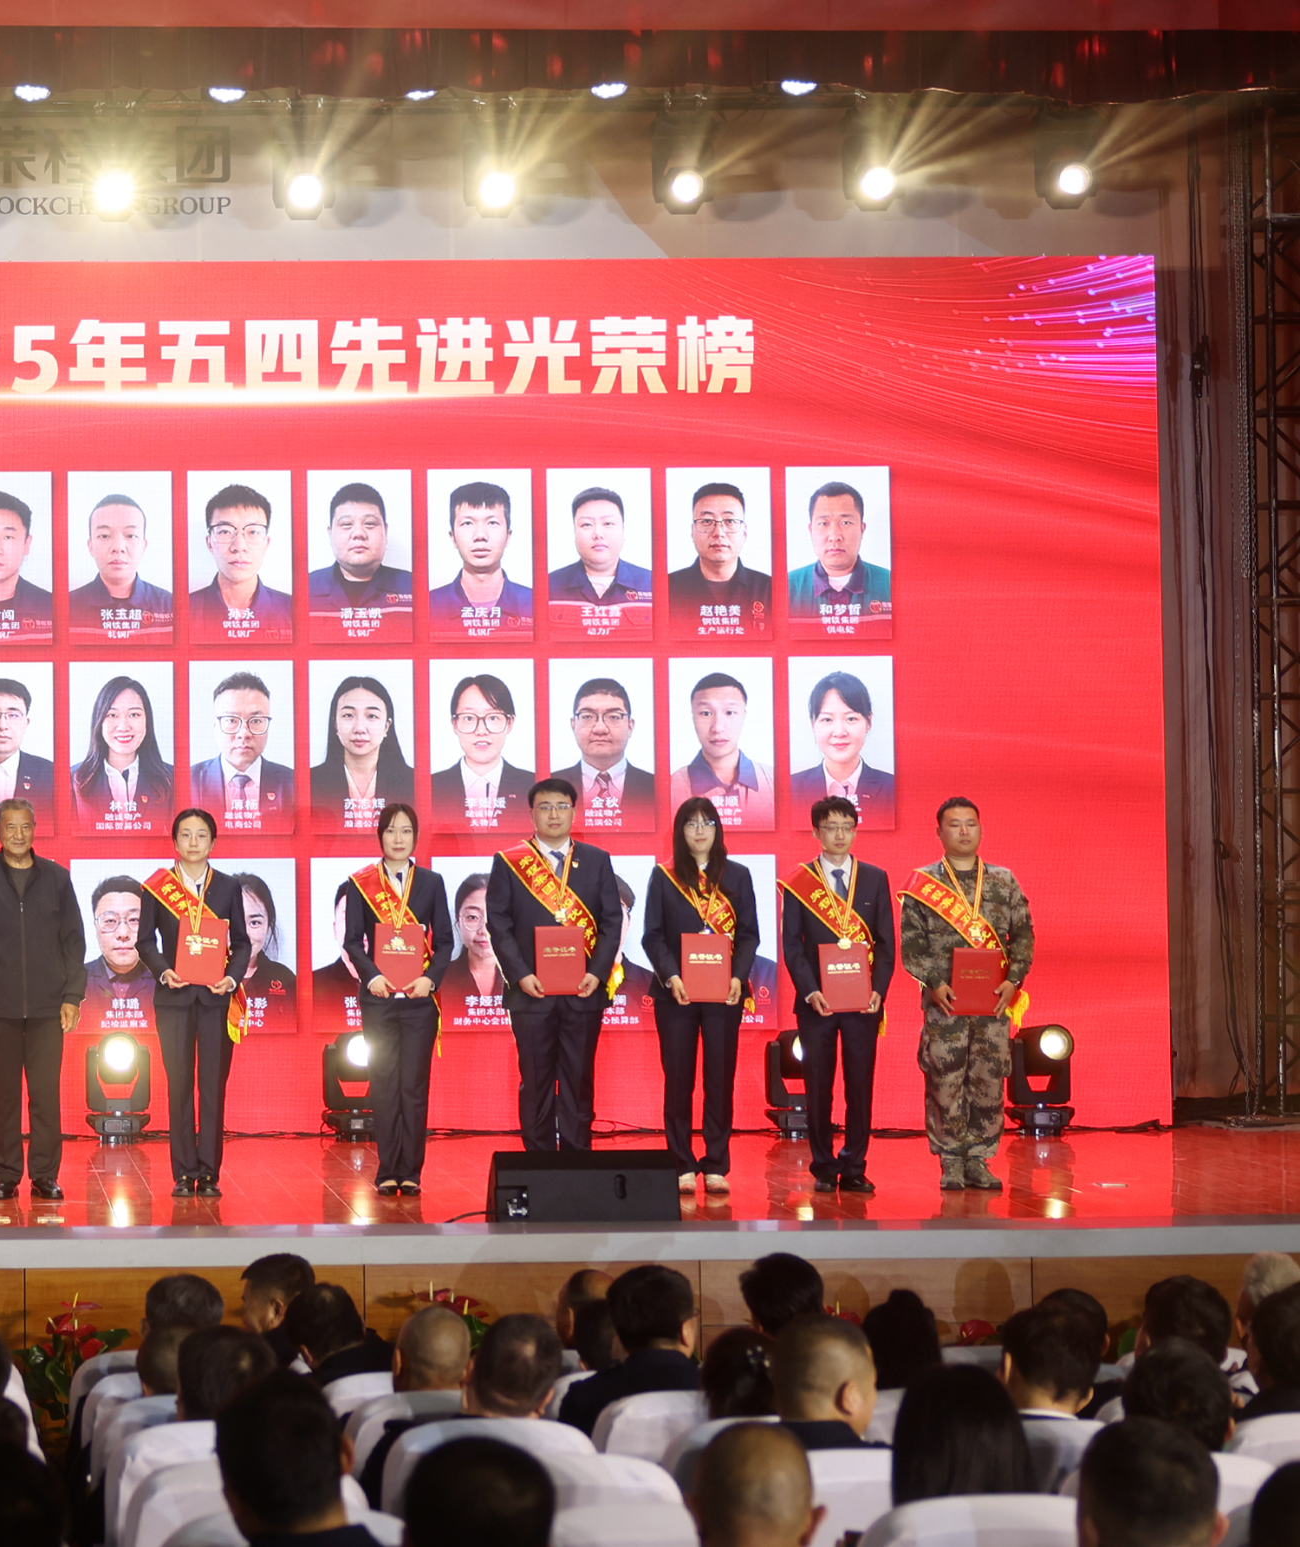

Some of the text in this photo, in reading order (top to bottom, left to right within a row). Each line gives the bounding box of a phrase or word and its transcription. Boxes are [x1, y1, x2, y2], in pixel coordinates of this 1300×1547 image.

[101, 608, 142, 620] 张玉超
[228, 608, 255, 620] 孙永
[341, 606, 382, 619] 潘玉凯
[103, 620, 140, 629] 钢铁集团
[223, 620, 260, 628] 钢铁集团
[343, 619, 380, 628] 钢铁集团
[463, 618, 500, 627] 钢铁集团
[582, 617, 619, 626] 钢铁集团
[702, 616, 739, 625] 钢铁集团
[821, 616, 858, 625] 钢铁集团
[110, 798, 137, 812] 林怡
[591, 796, 618, 808] 金秋
[95, 821, 150, 830] 国际贸易公司
[112, 998, 140, 1010] 韩璐
[468, 1008, 505, 1016] 集团本部
[101, 1020, 148, 1028] 纪检监察室
